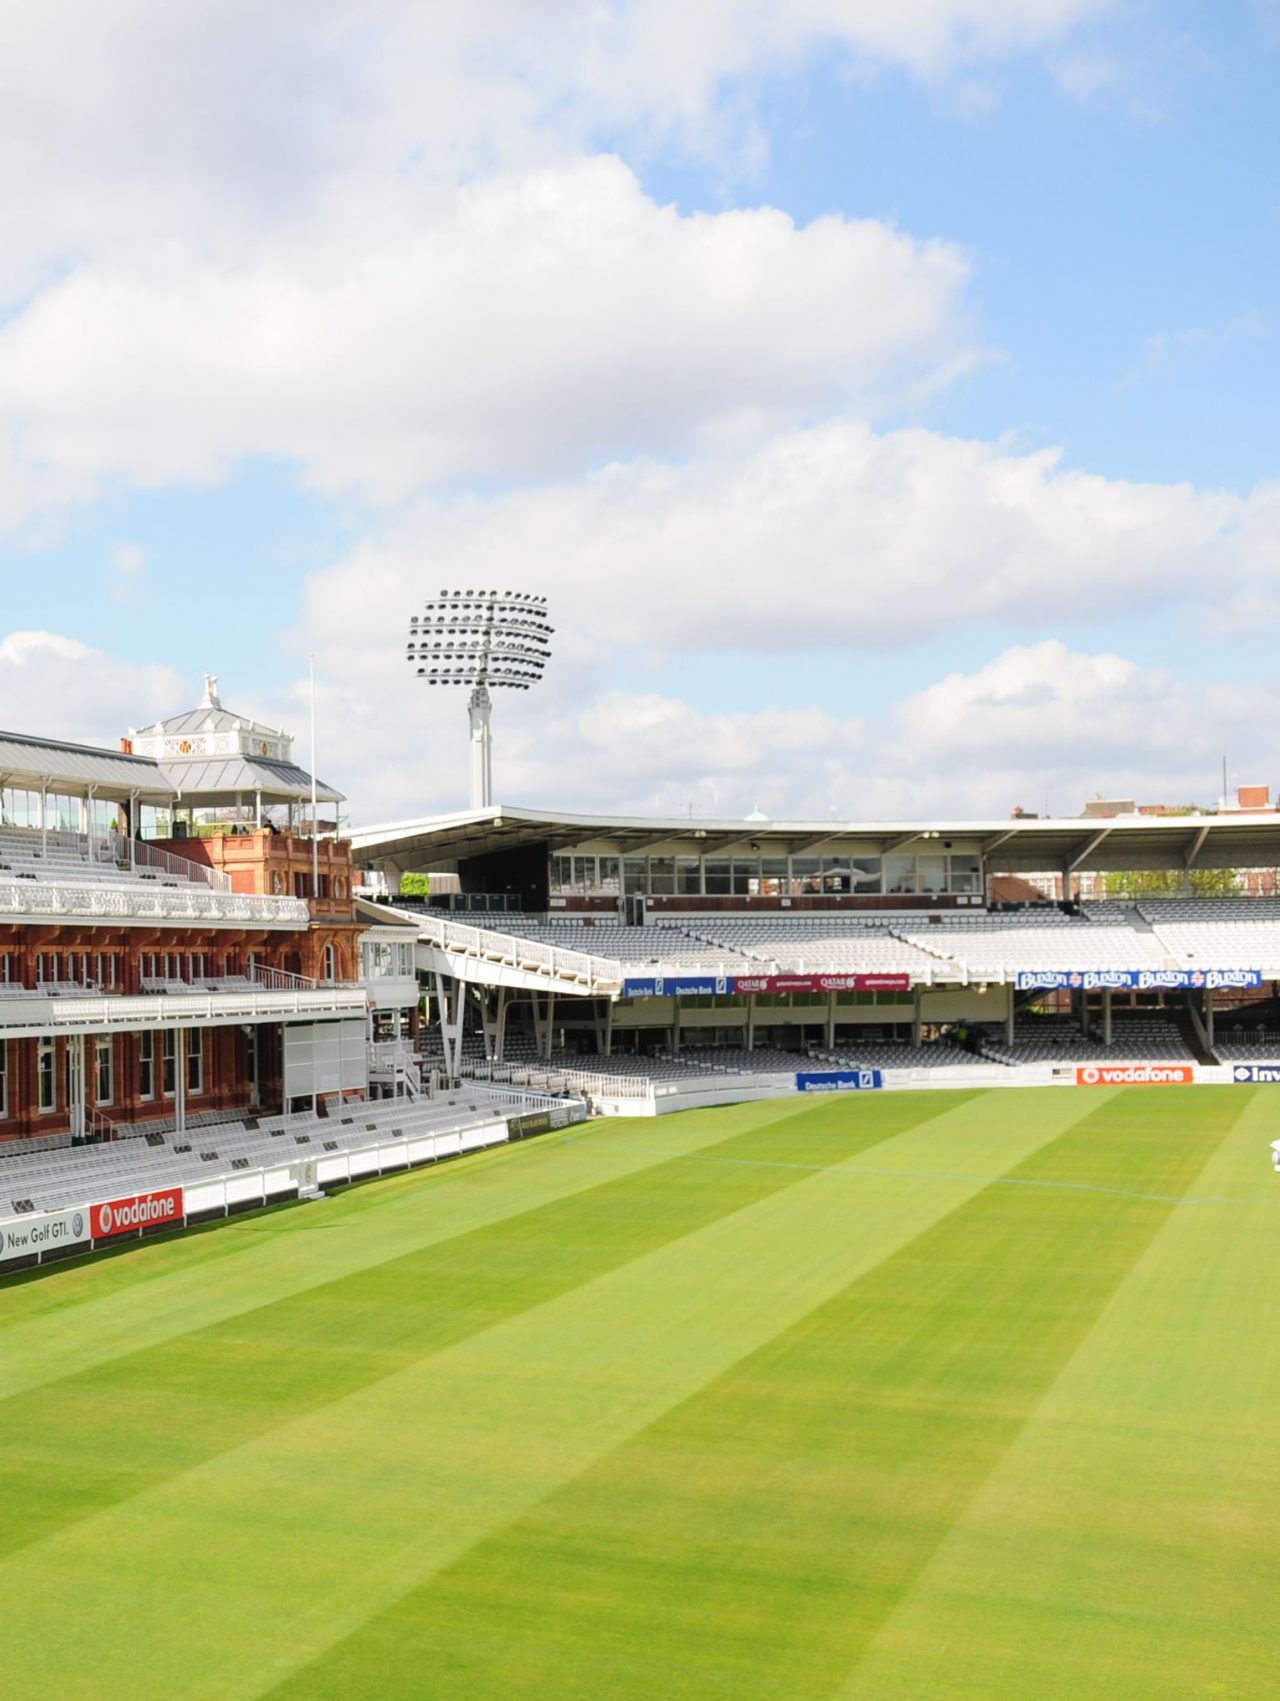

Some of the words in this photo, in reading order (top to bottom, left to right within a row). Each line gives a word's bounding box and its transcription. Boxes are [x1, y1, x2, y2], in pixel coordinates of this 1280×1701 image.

[1103, 1066, 1184, 1082] vodafone
[113, 1195, 175, 1228] vodafone
[7, 1232, 29, 1249] New
[30, 1223, 50, 1244] Golf
